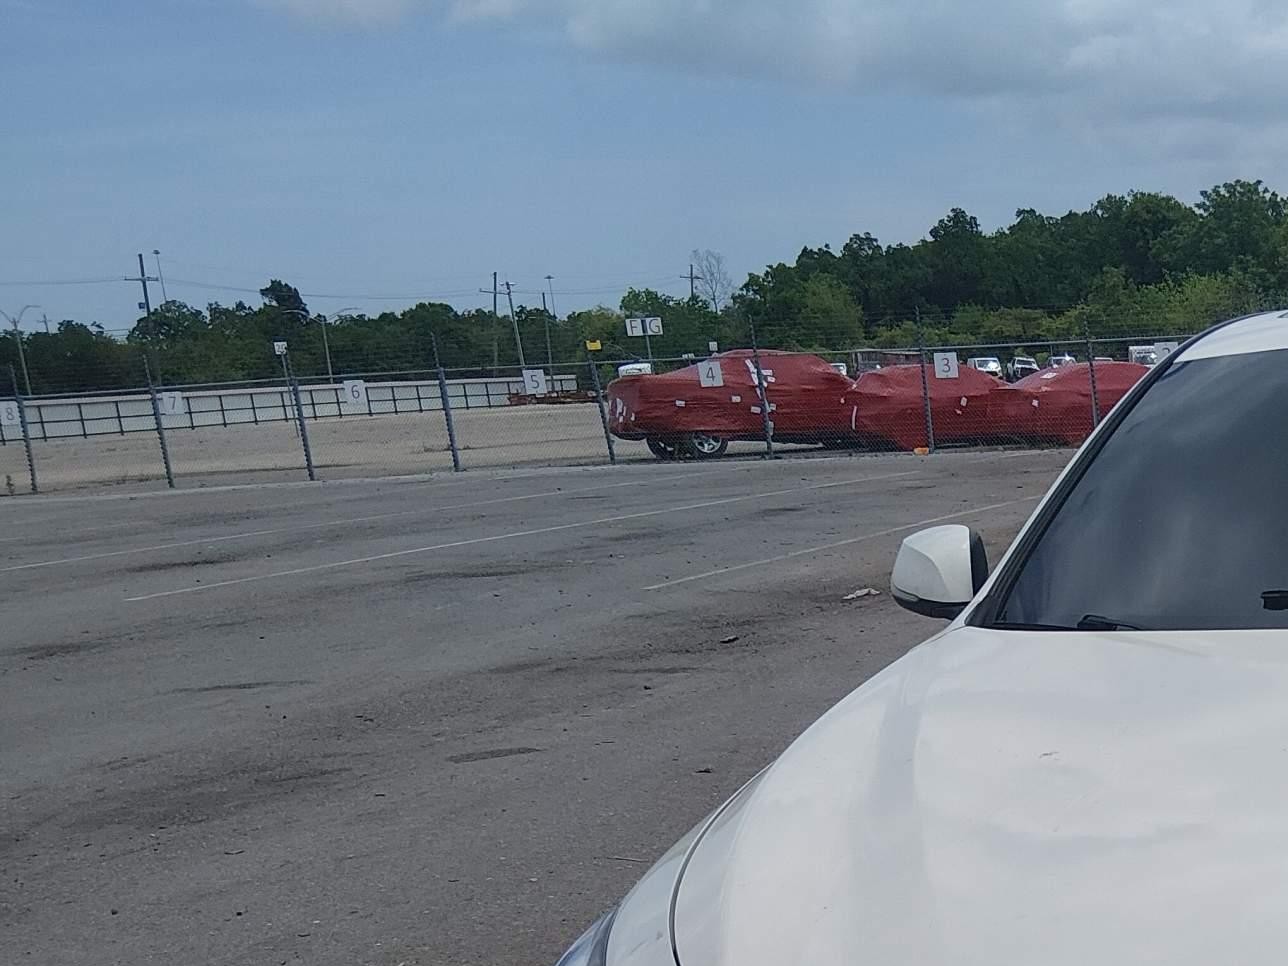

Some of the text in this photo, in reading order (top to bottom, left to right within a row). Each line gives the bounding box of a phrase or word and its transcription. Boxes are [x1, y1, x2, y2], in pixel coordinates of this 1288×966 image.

[629, 319, 638, 336] F
[648, 318, 661, 334] G
[941, 357, 951, 373] 3
[530, 374, 540, 389] 5
[705, 366, 716, 383] 4
[350, 384, 361, 400] 6
[168, 396, 177, 410] 7
[6, 406, 15, 421] 8
